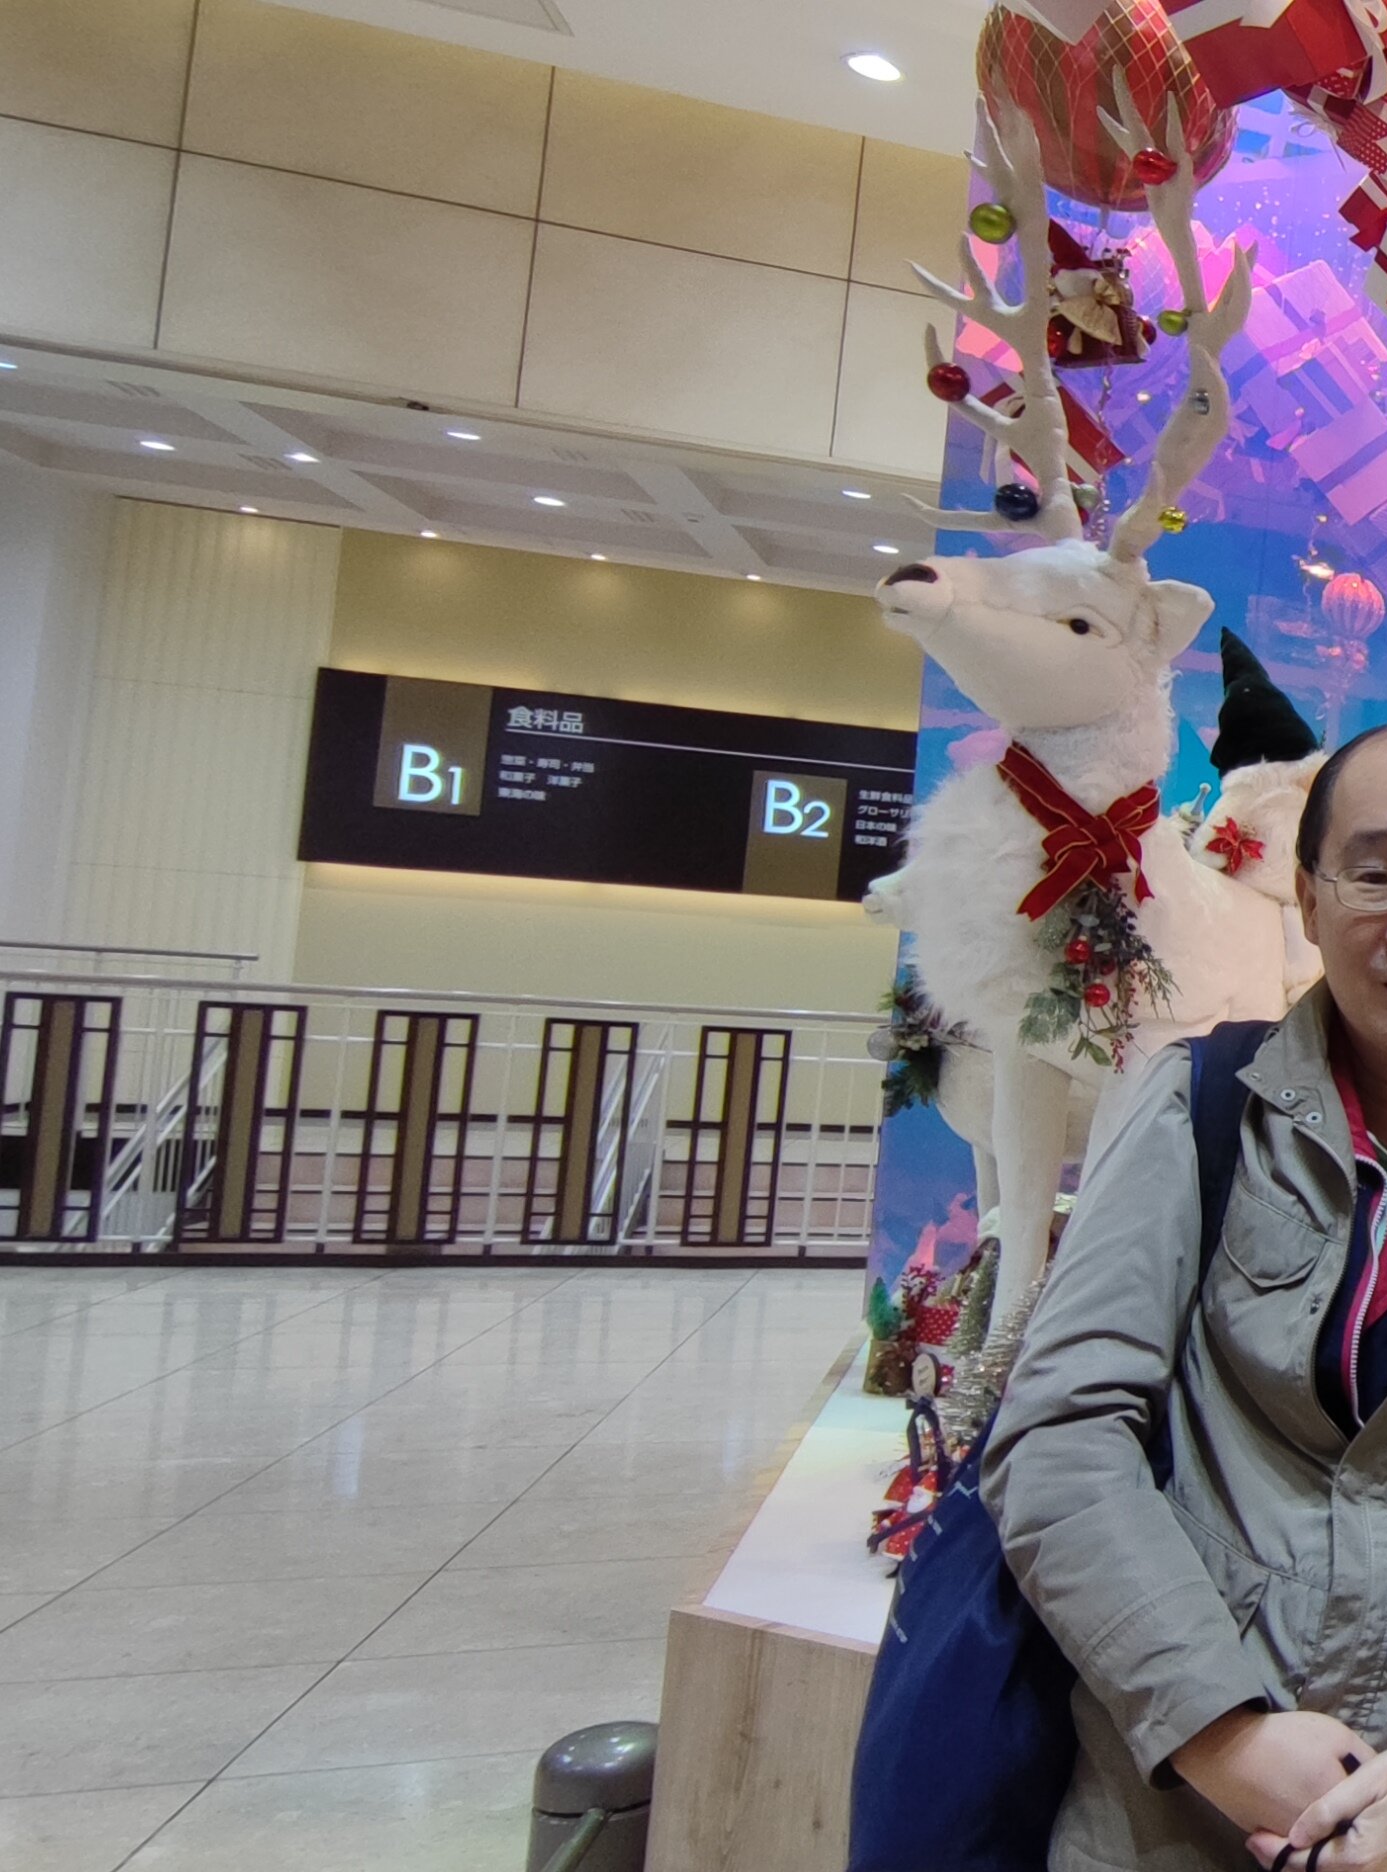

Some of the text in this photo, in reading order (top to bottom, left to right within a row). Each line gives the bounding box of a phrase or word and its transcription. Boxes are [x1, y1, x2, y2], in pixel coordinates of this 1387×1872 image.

[507, 705, 585, 734] 食料品
[398, 743, 463, 806] B1
[763, 779, 831, 839] B2
